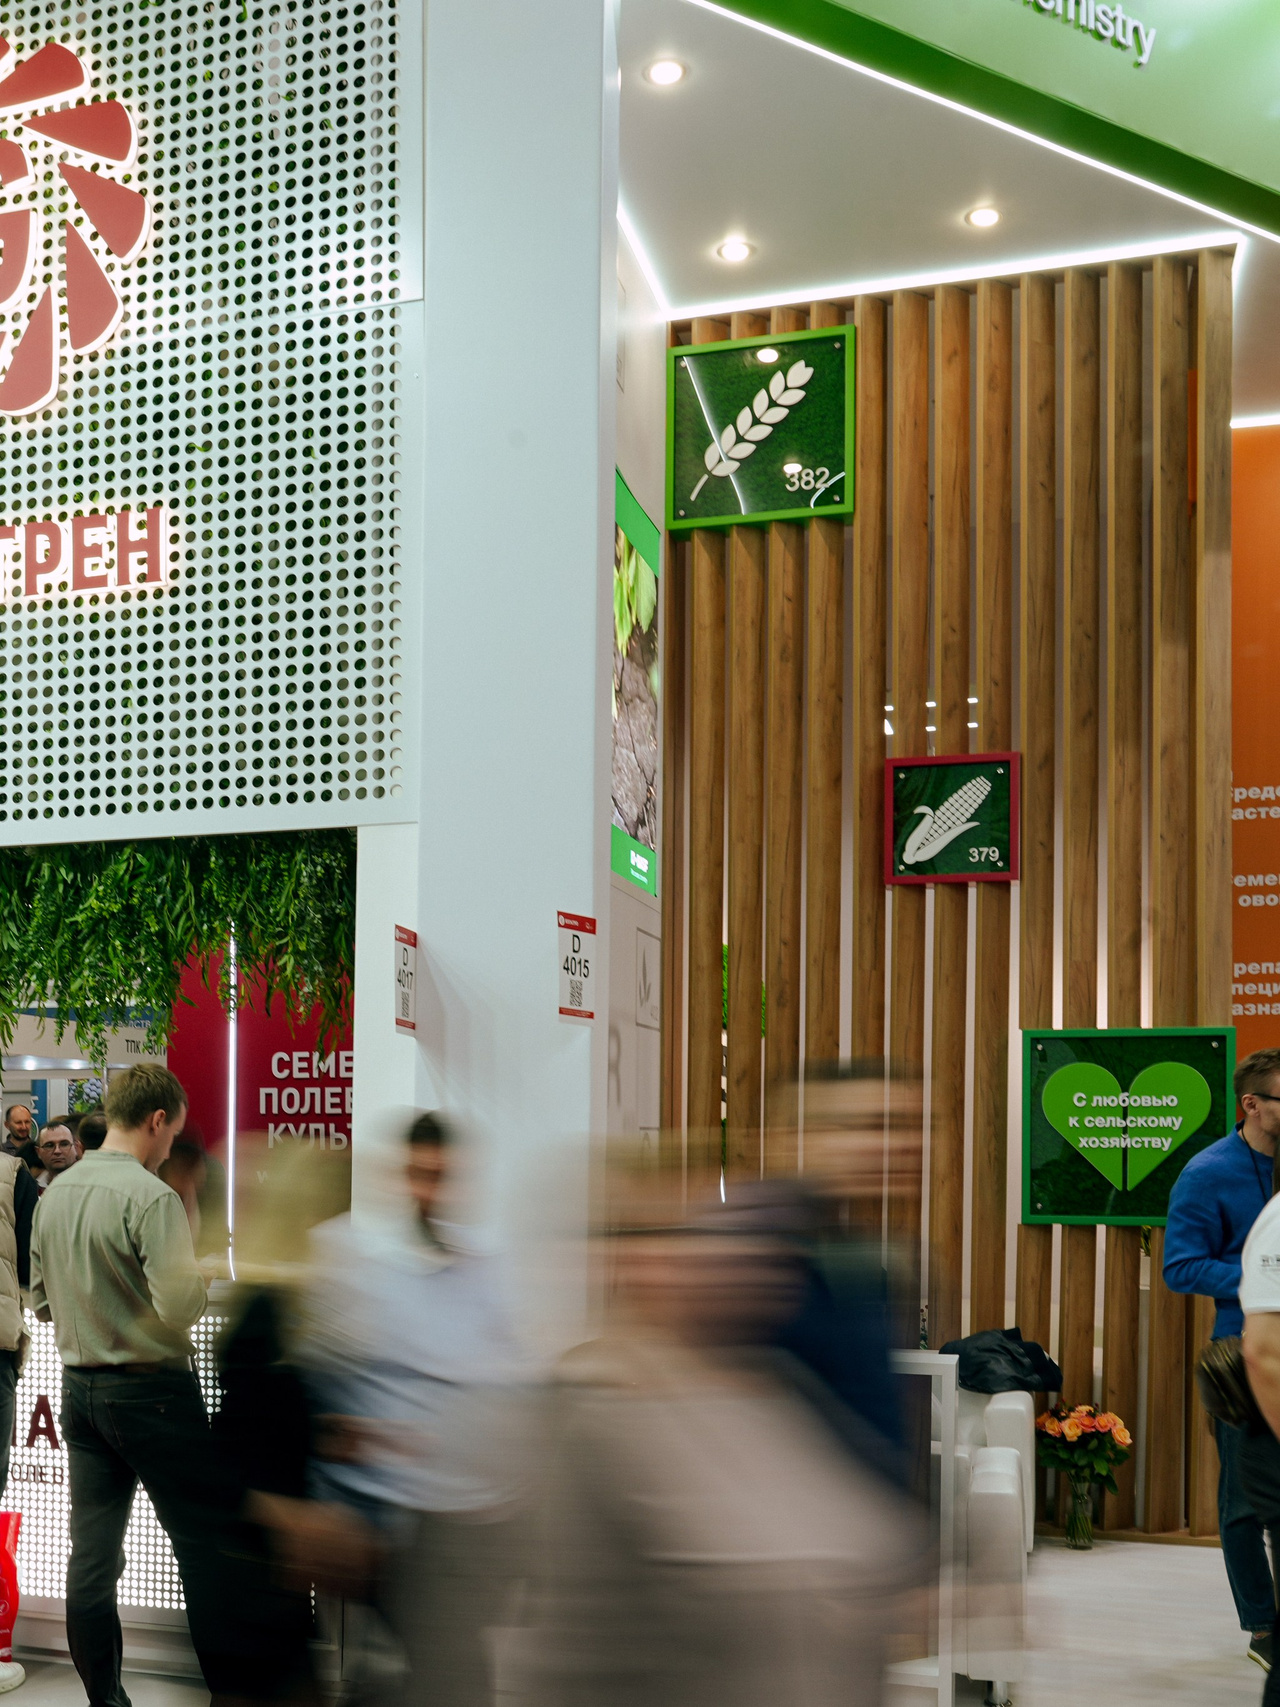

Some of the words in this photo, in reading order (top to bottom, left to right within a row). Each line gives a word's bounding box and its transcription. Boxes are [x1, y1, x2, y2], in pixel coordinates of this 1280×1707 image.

[1026, 0, 1157, 64] mistry
[785, 466, 830, 492] 382
[1231, 786, 1280, 803] ред
[969, 847, 1000, 862] 379
[1231, 873, 1280, 887] еме
[1238, 893, 1280, 907] ово
[572, 934, 581, 954] D
[403, 947, 409, 966] D
[563, 955, 590, 978] 4015
[397, 968, 413, 990] 4017
[271, 1051, 354, 1079] СЕМЕ
[1073, 1092, 1087, 1108] С
[1091, 1092, 1178, 1108] любовью
[1069, 1116, 1080, 1128] к
[1084, 1116, 1183, 1131] сельскому
[1079, 1133, 1172, 1152] хозяйству
